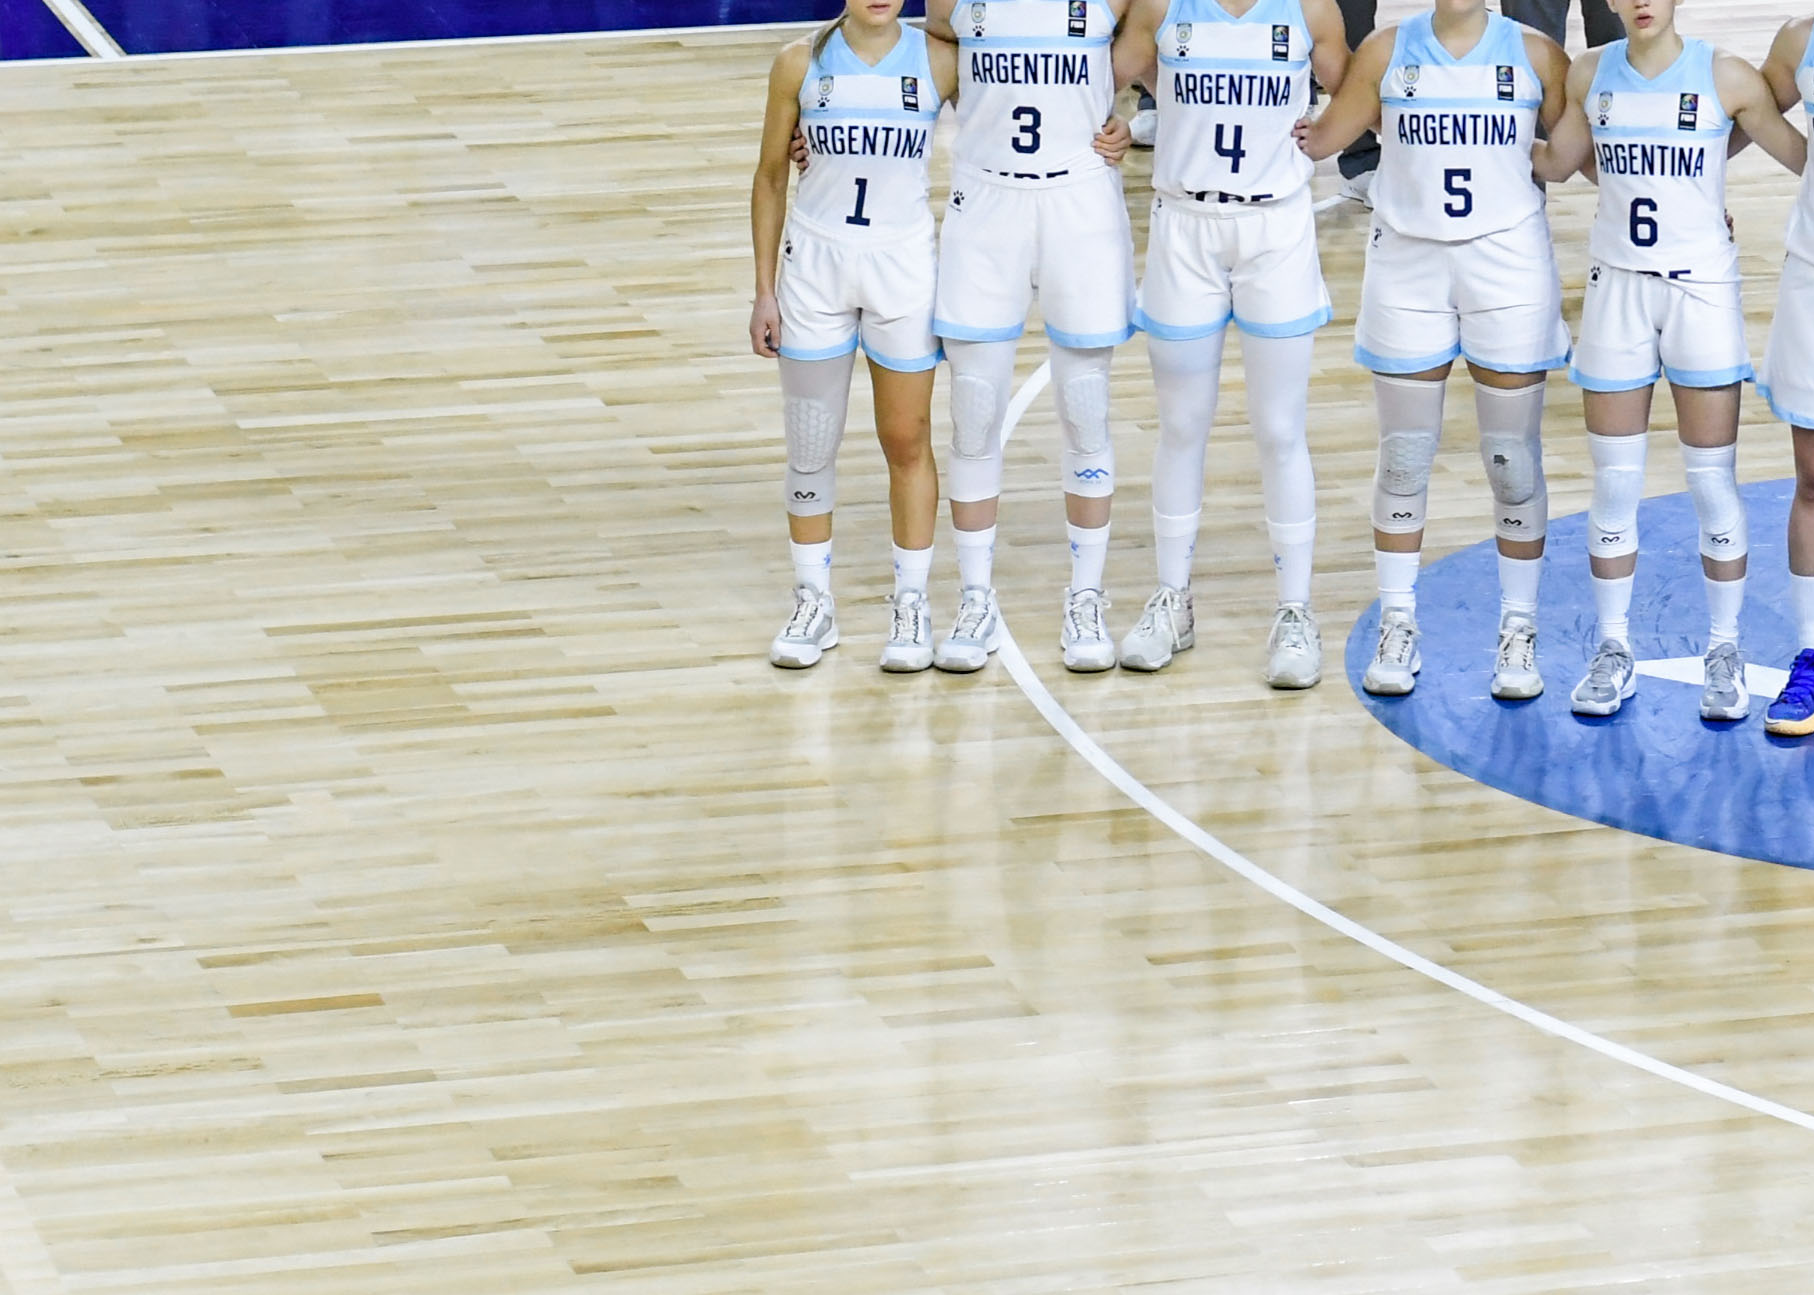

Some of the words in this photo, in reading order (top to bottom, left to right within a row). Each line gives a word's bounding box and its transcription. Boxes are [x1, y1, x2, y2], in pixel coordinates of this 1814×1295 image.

[971, 52, 1089, 85] ARGENTINA
[1174, 72, 1291, 107] ARGENTINA
[807, 125, 927, 159] ARGENTINA
[1011, 106, 1042, 154] 3
[1214, 123, 1246, 174] 4
[1398, 113, 1517, 145] ARGENTINA
[1596, 143, 1705, 178] ARGENTINA
[845, 177, 871, 227] 1
[1444, 168, 1473, 218] 5
[1629, 197, 1658, 247] 6
